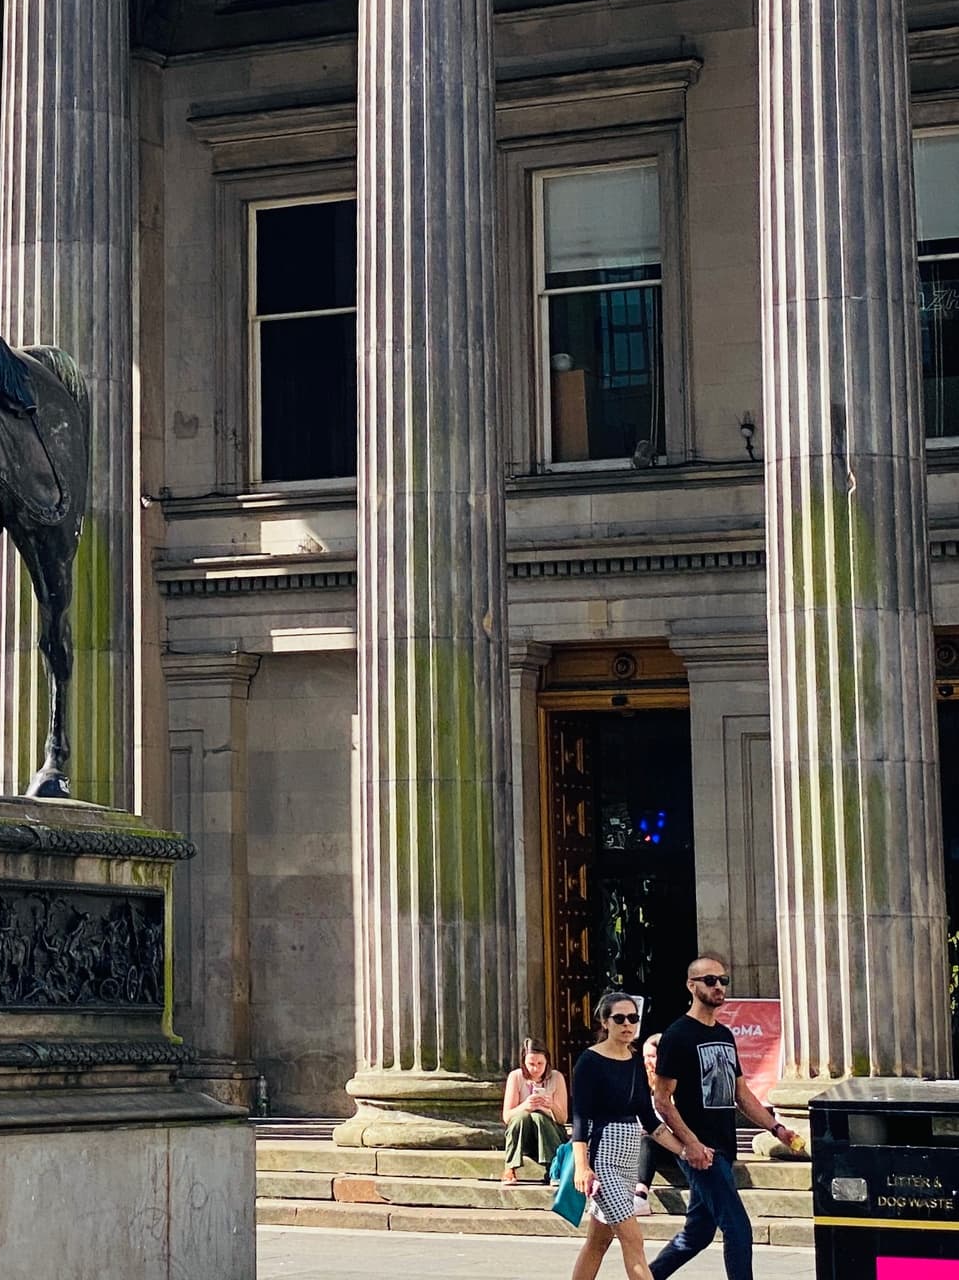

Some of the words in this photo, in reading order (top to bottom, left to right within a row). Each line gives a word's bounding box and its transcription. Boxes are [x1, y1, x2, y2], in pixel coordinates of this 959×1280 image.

[727, 1024, 764, 1037] oMA
[887, 1174, 931, 1188] LITTER
[877, 1196, 907, 1208] DOG
[908, 1198, 954, 1209] WASTE
